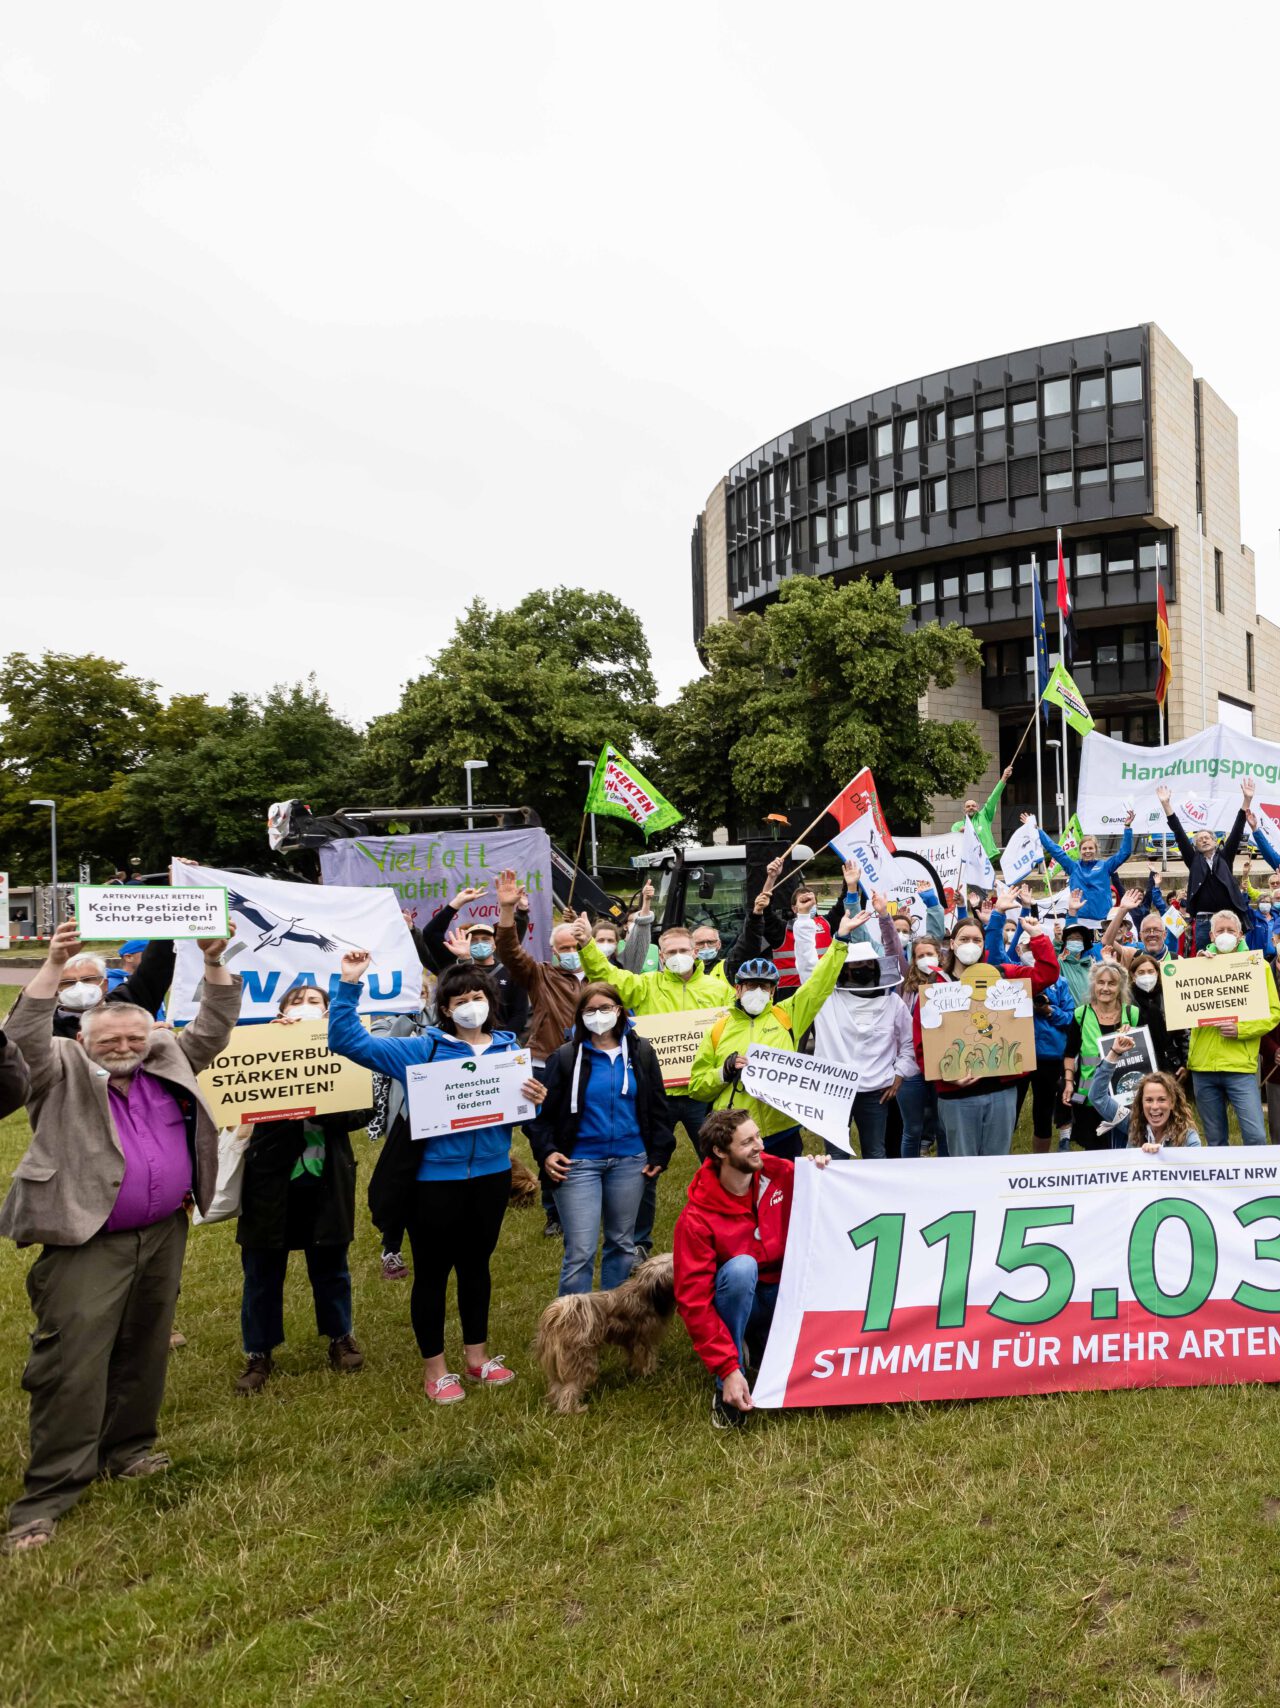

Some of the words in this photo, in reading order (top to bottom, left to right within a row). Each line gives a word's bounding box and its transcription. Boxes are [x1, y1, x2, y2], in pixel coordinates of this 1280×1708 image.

[354, 840, 490, 873] Vielfalt
[852, 846, 880, 884] NABU
[88, 903, 132, 912] Keine
[137, 902, 201, 912] Pestizide
[205, 902, 218, 912] in
[95, 912, 213, 924] Schutzgebieten!
[1175, 971, 1252, 989] NATIONALPARK
[1180, 990, 1192, 1001] IN
[1194, 988, 1214, 999] DER
[1216, 984, 1250, 997] SENNE
[933, 998, 968, 1010] SCHUTZ
[1186, 998, 1248, 1013] AUSWEISEN!
[212, 1067, 298, 1088] STÄRKEN
[304, 1062, 342, 1077] UND
[746, 1065, 820, 1092] STOPPEN
[445, 1077, 500, 1091] Artenschutz
[221, 1081, 334, 1105] AUSWEITEN!
[446, 1094, 455, 1102] in
[457, 1091, 473, 1100] der
[475, 1086, 500, 1097] Stadt
[456, 1099, 492, 1111] fördern
[1008, 1171, 1128, 1190] VOLKSINITIATIVE
[1132, 1168, 1241, 1182] ARTENVIELFALT
[1245, 1167, 1277, 1180] NRW
[811, 1340, 980, 1379] STIMMEN
[991, 1331, 1061, 1369] FÜR
[1072, 1331, 1169, 1365] MEHR
